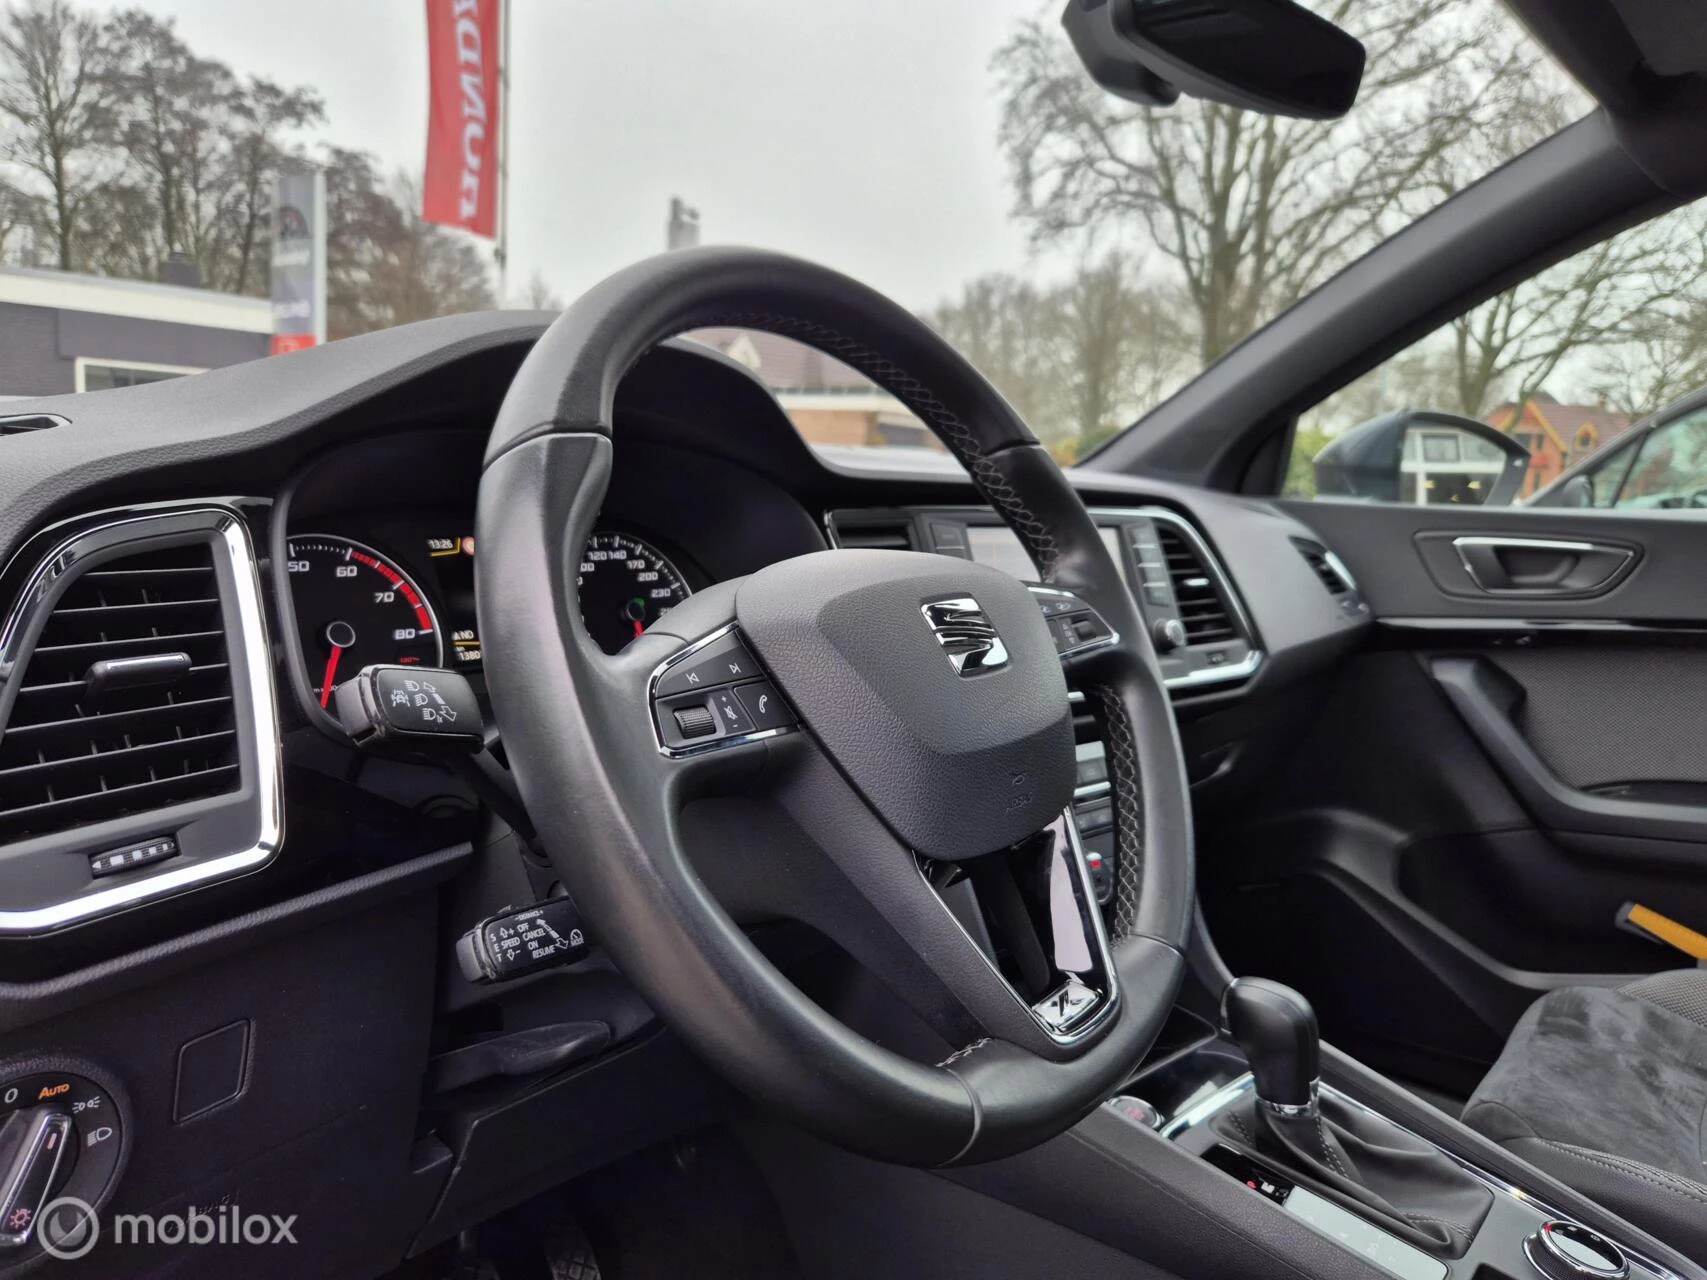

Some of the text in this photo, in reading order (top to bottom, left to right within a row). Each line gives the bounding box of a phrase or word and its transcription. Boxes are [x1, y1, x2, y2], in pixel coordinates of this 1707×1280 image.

[588, 550, 627, 561] 120 140
[287, 561, 310, 572] 50
[580, 562, 595, 572] 00
[627, 560, 646, 570] 170
[336, 566, 358, 577] 60
[637, 571, 659, 582] 200
[374, 592, 395, 603] 70
[650, 588, 672, 598] 230
[394, 628, 416, 640] 80
[517, 923, 528, 932] OFF
[522, 929, 545, 941] CANCEL
[501, 937, 520, 949] SPEED
[528, 940, 538, 950] ON
[532, 945, 555, 958] RESUME
